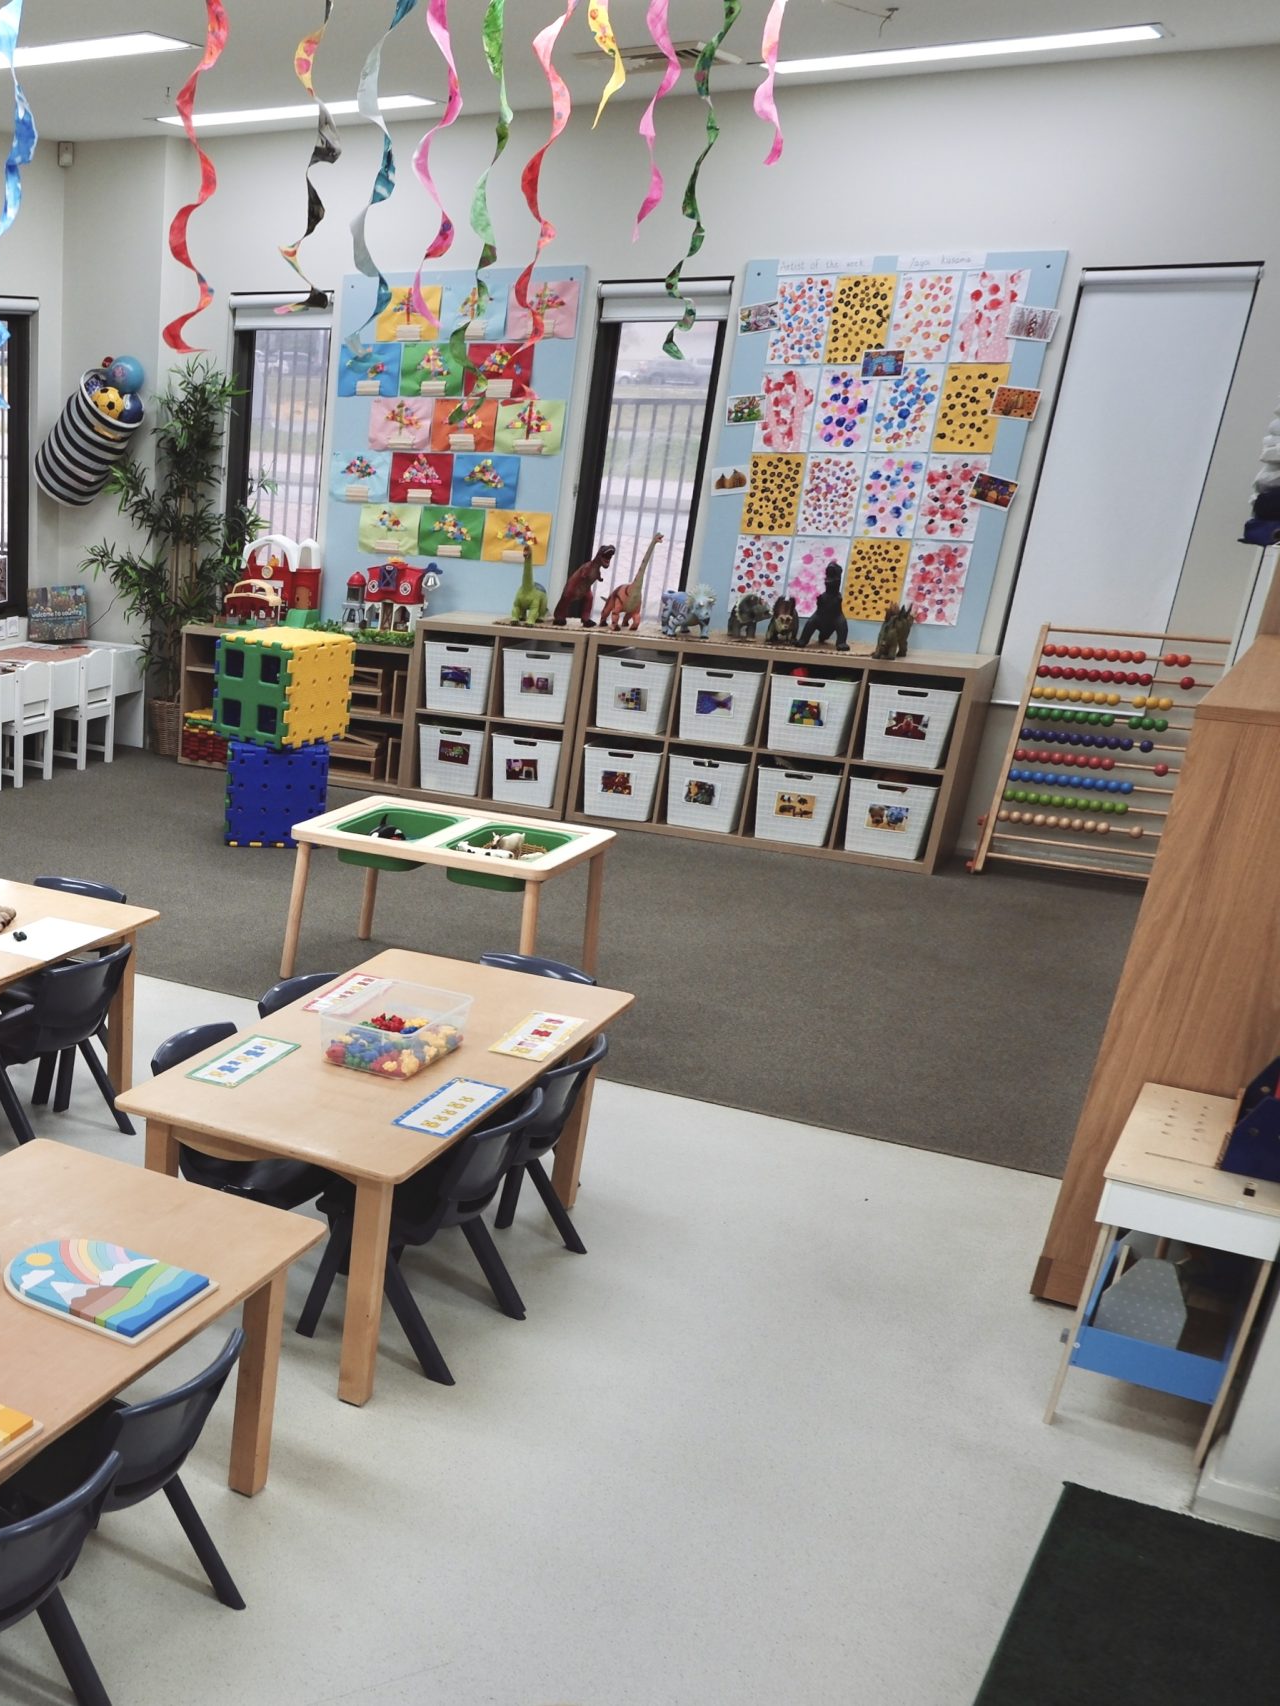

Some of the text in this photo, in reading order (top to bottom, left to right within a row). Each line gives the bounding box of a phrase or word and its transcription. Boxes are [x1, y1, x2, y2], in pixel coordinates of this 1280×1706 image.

[780, 260, 805, 271] Artist
[826, 259, 840, 269] the
[846, 258, 864, 268] week
